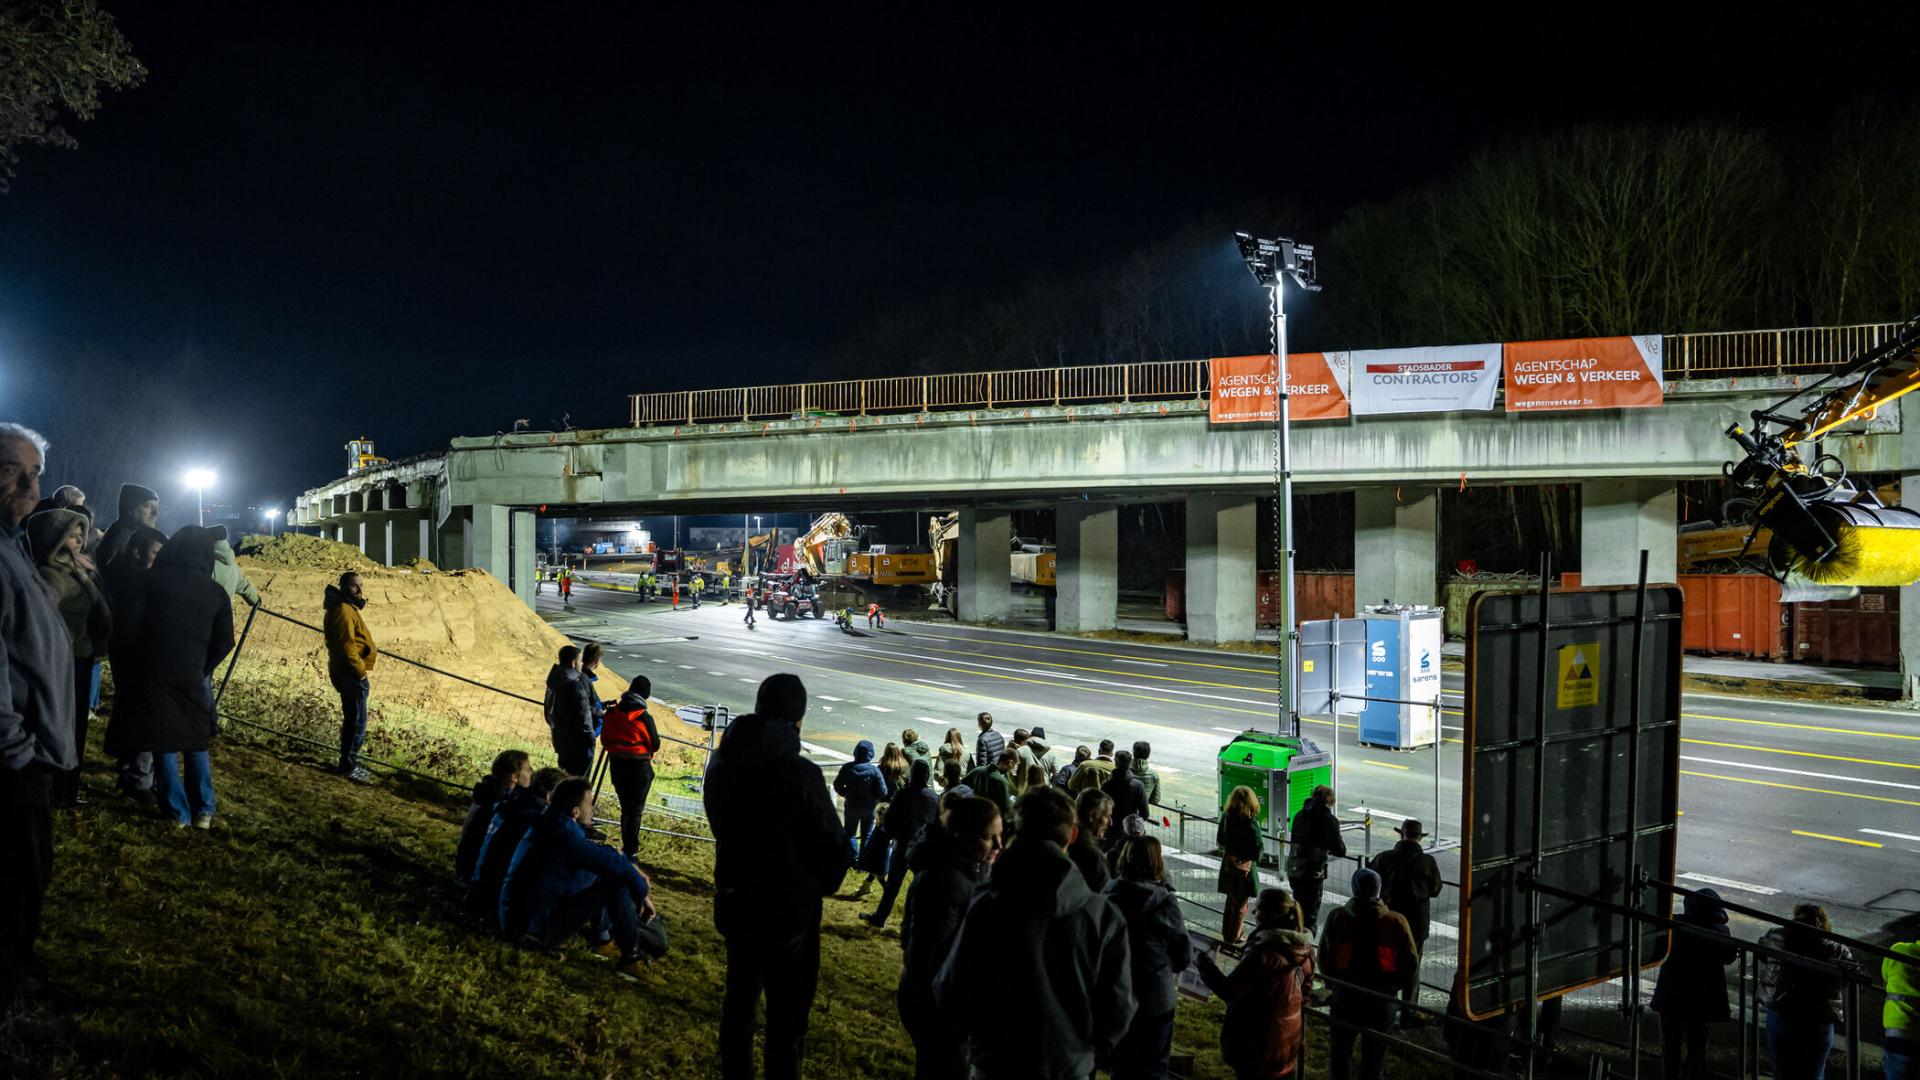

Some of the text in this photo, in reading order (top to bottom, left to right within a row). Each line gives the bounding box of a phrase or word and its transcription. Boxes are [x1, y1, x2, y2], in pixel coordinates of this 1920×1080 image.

[1398, 364, 1452, 373] STADSBADER
[1514, 358, 1598, 372] AGENTSCHAP
[1373, 372, 1478, 385] CONTRACTORS
[1514, 370, 1641, 385] WEGEN & VERKEER
[1219, 387, 1260, 398] WEGEN
[1264, 385, 1273, 395] &
[1413, 674, 1438, 683] sarens
